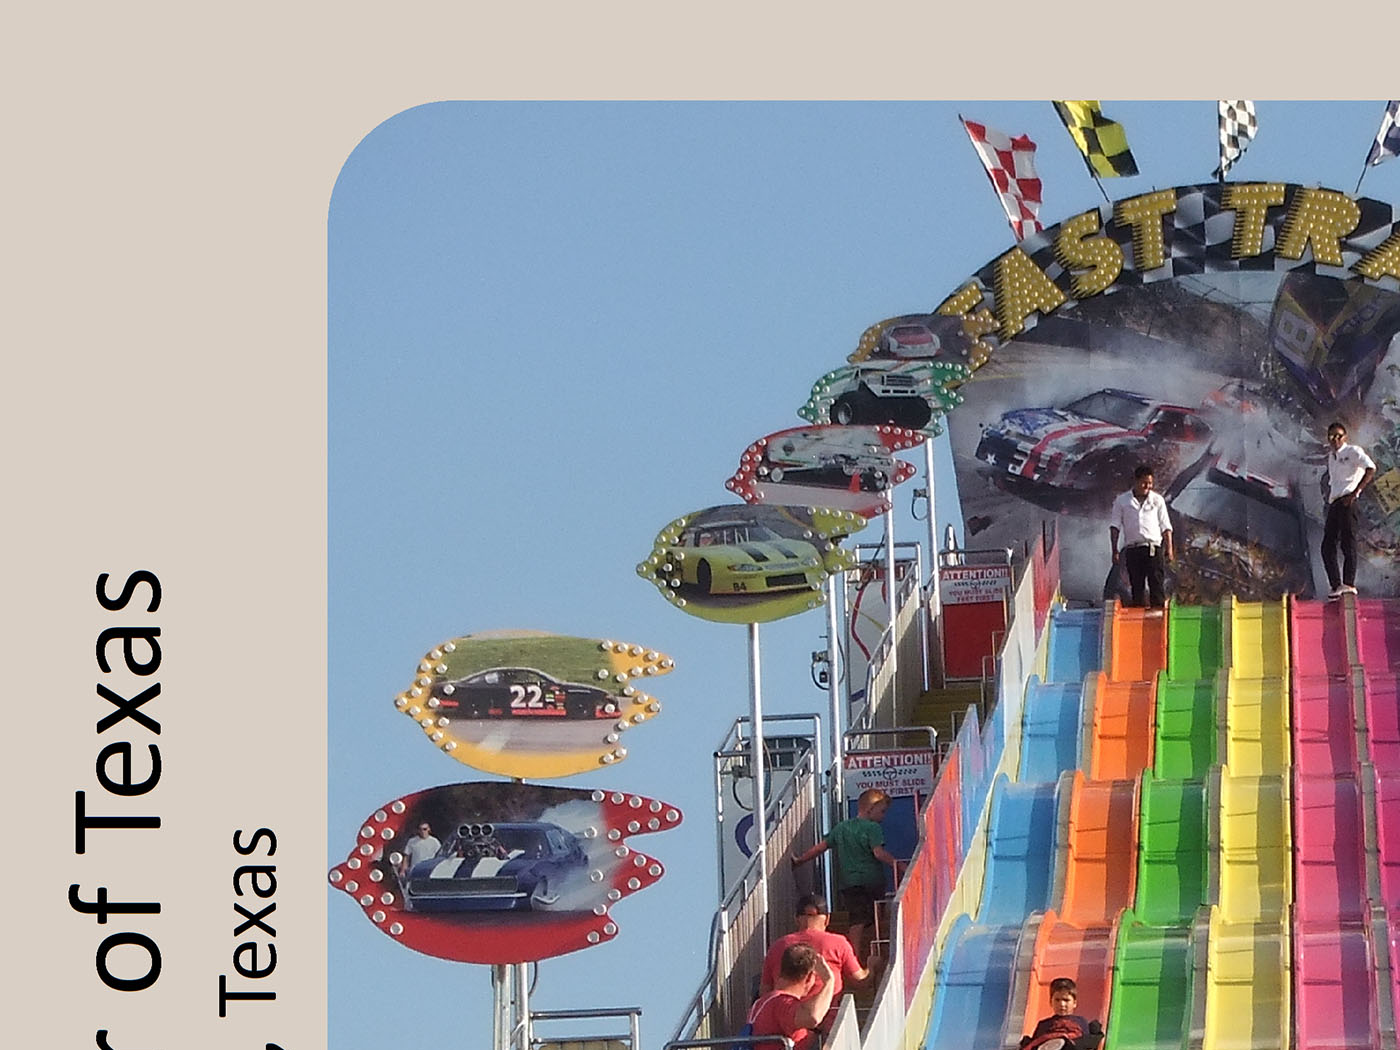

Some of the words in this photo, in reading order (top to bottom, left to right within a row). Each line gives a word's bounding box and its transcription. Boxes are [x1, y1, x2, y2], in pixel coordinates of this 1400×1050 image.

[943, 569, 1007, 580] ATTENTION!!
[510, 685, 543, 708] 22
[848, 753, 931, 769] ATTENTION!!
[856, 781, 873, 789] YOU
[890, 787, 913, 795] FIRST
